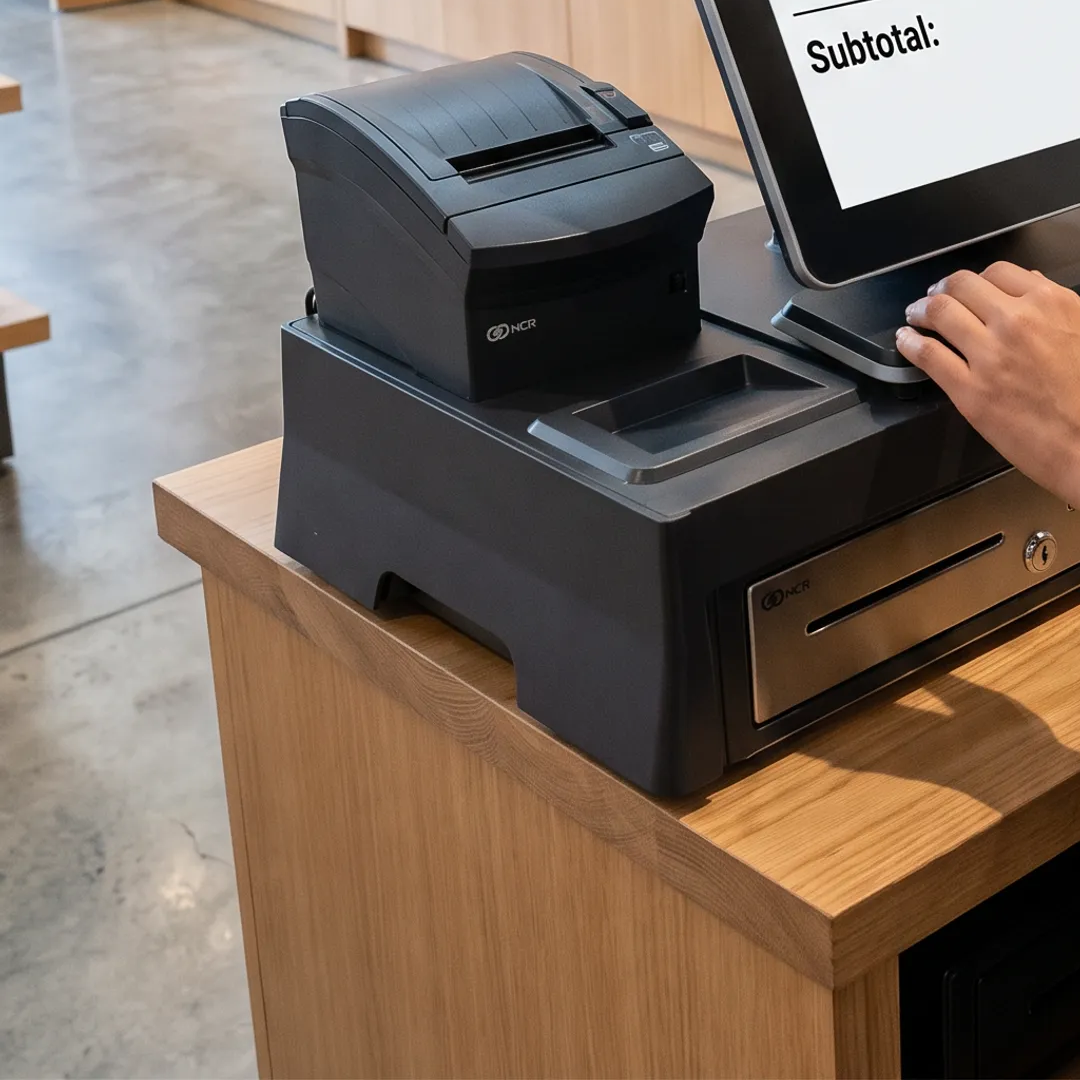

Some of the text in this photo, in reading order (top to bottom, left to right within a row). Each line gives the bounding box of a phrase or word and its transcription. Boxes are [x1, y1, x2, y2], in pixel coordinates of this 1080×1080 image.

[806, 14, 940, 74] Subtotal:
[511, 318, 537, 334] NCR
[785, 580, 811, 598] NCR
